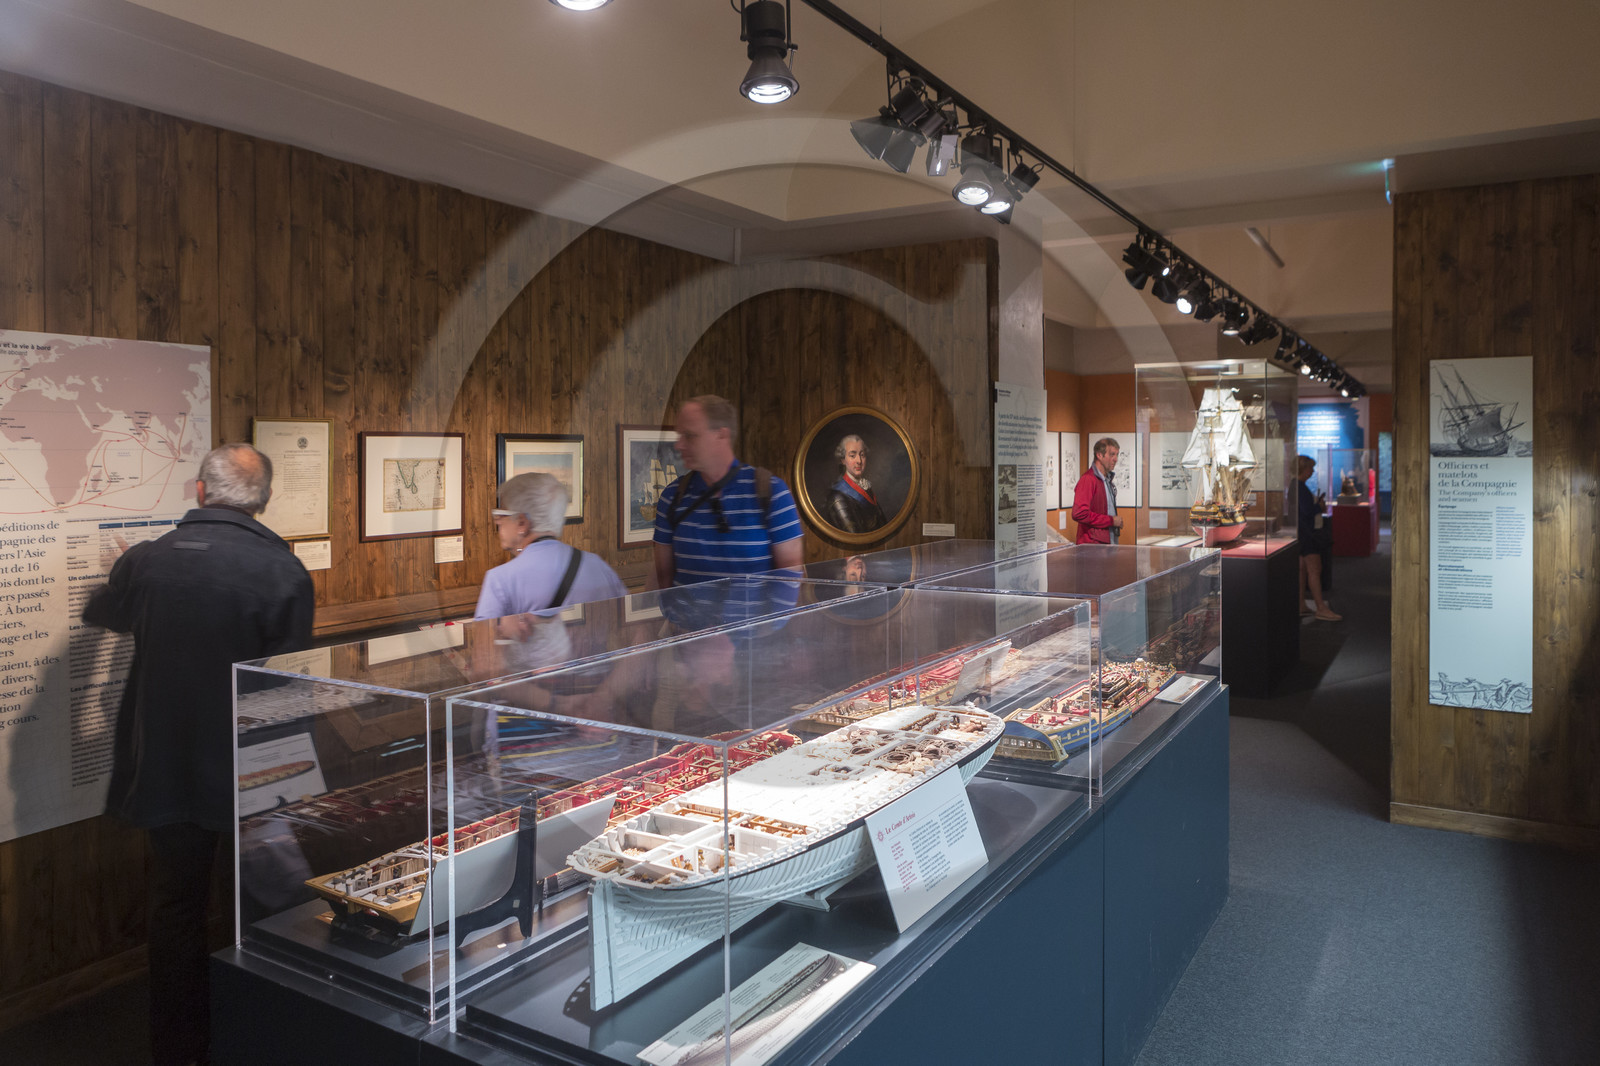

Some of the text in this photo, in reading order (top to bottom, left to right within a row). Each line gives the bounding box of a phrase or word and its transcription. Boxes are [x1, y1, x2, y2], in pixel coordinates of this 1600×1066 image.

[1438, 461, 1478, 470] Officiers
[1462, 480, 1517, 490] Compagnie
[0, 520, 60, 532] éditions de
[38, 535, 56, 544] des
[18, 549, 46, 559] l'Asie
[11, 564, 24, 573] de
[28, 562, 40, 572] 16
[14, 578, 39, 586] dont
[41, 575, 56, 584] les
[17, 589, 50, 603] passés
[5, 602, 45, 615] À bord,
[0, 635, 20, 646] age
[34, 630, 49, 639] les
[34, 658, 40, 666] à
[42, 656, 60, 665] des
[20, 686, 33, 696] de
[36, 684, 44, 693] la
